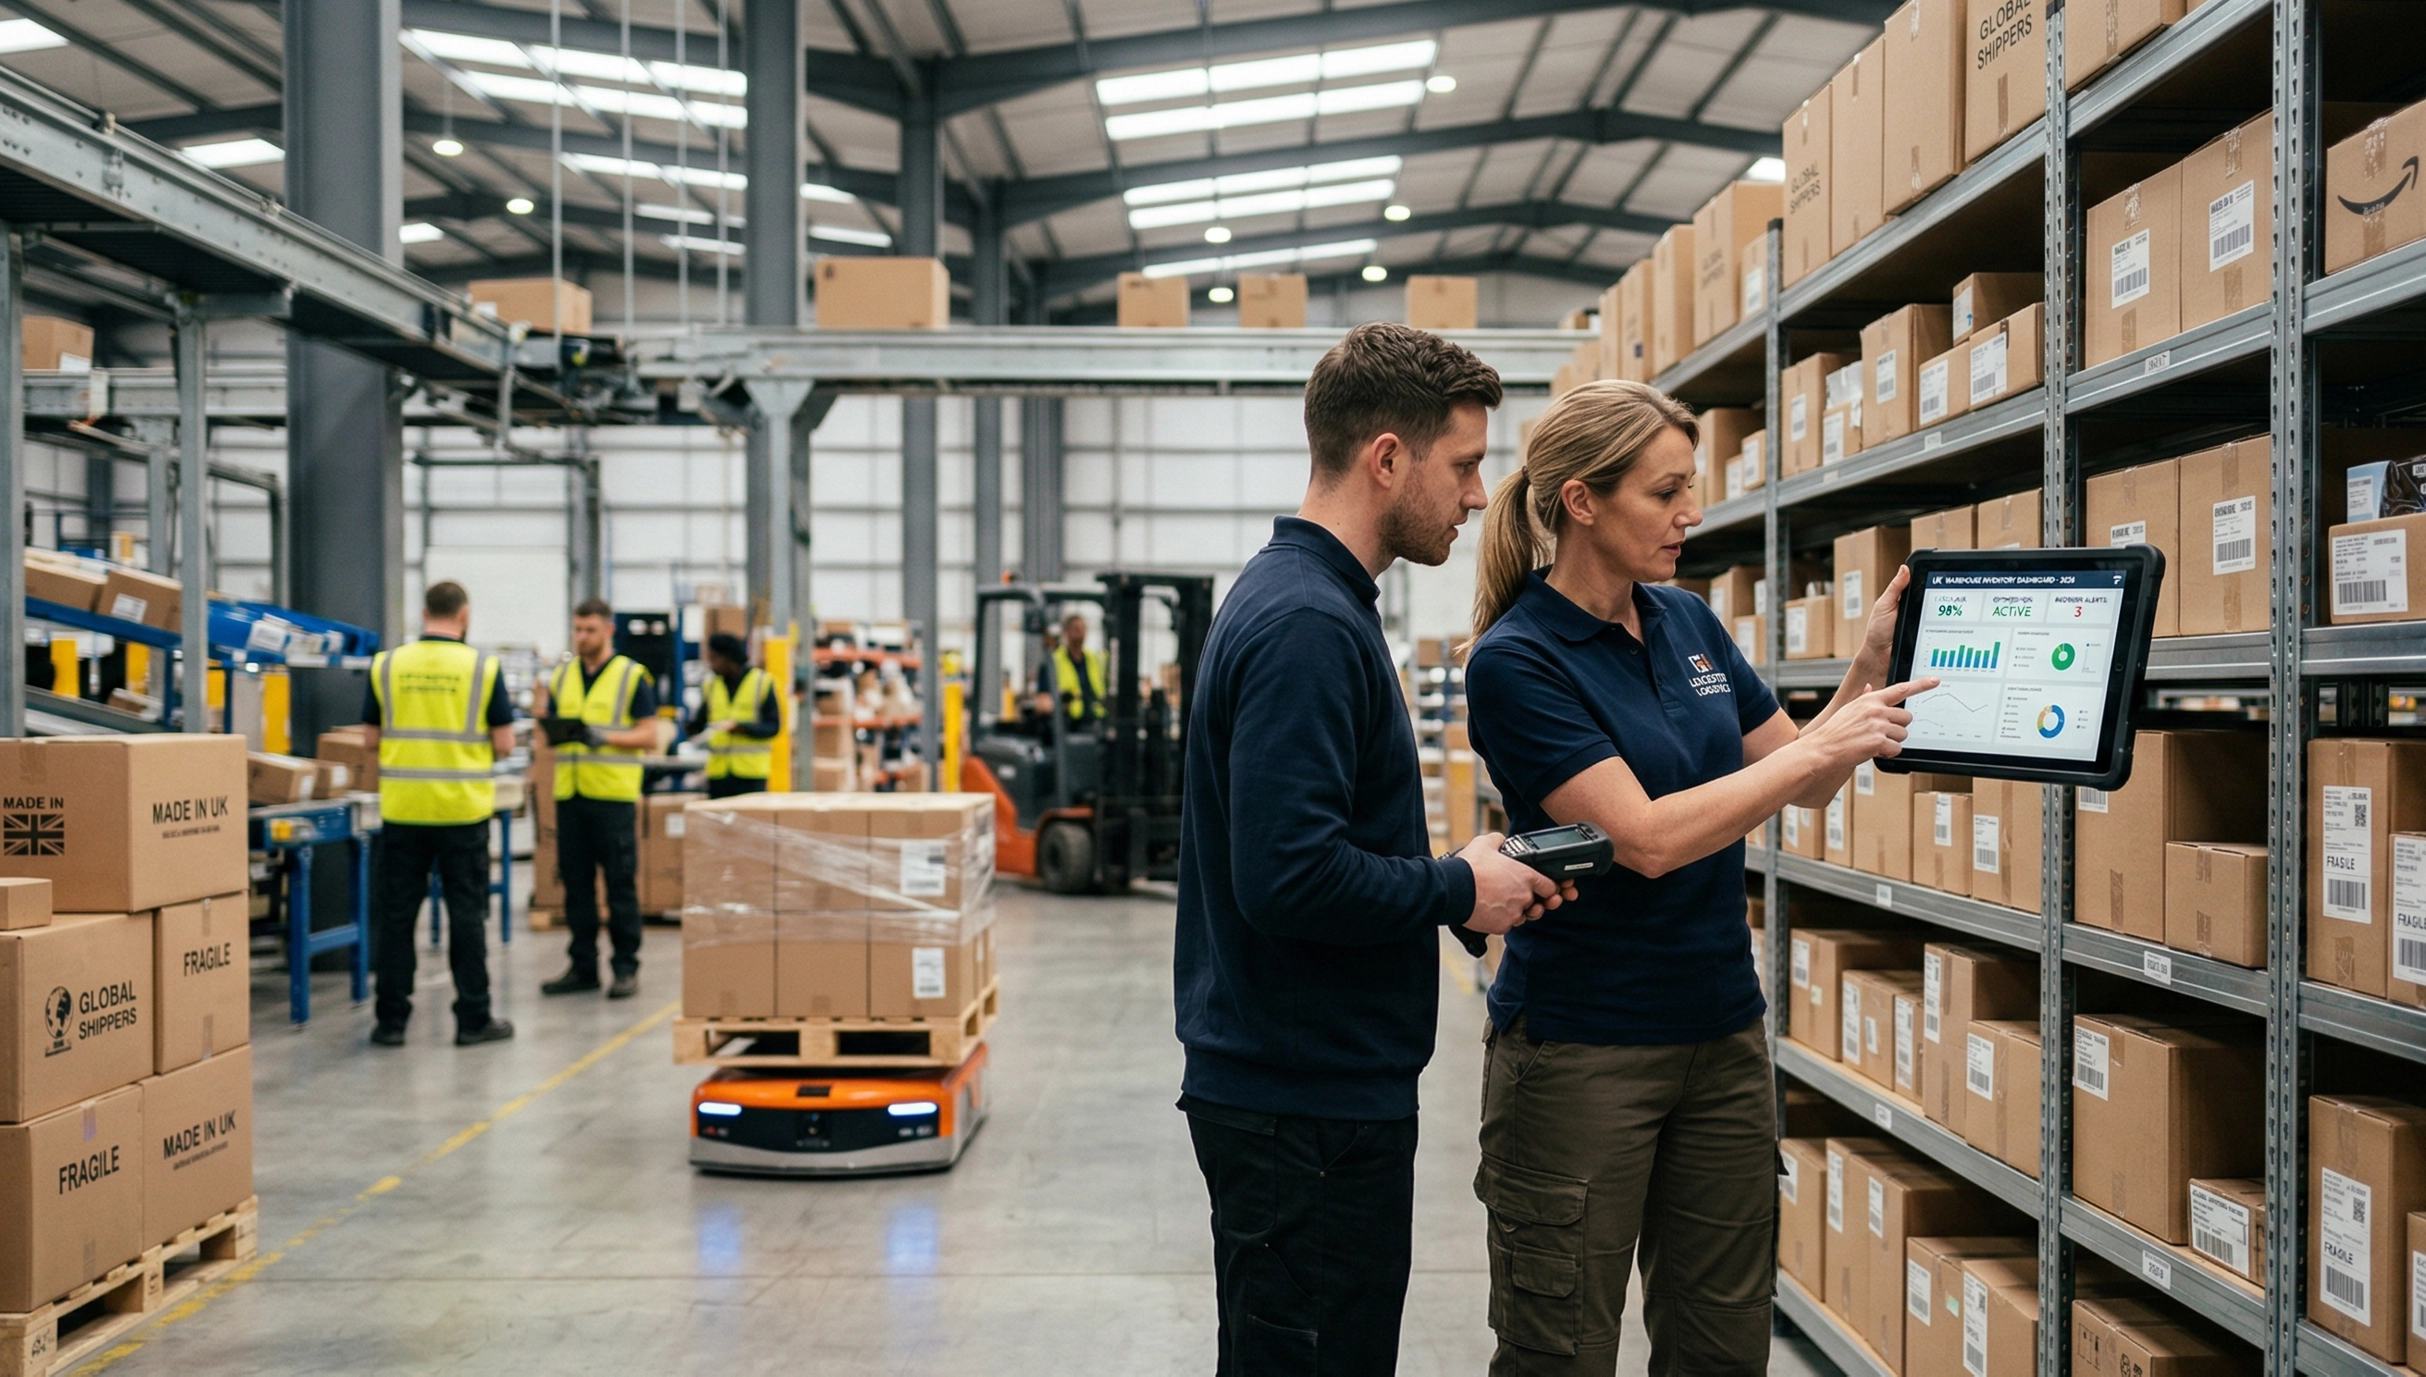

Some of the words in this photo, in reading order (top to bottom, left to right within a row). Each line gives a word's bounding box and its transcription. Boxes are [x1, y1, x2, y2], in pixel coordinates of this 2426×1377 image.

[1977, 13, 2032, 70] SHIPPERS
[1938, 605, 1962, 617] 98%
[1992, 606, 2032, 617] ACTIVE
[2074, 606, 2082, 617] 3
[4, 797, 45, 809] MADE
[50, 797, 64, 809] IN
[153, 800, 191, 825] MADE
[195, 798, 208, 820] IN
[211, 795, 229, 817] UK
[184, 942, 231, 977] FRAGILE
[79, 980, 137, 1015] GLOBAL
[79, 1007, 137, 1040] SHIPPERS
[164, 1124, 200, 1160] MADE
[204, 1117, 216, 1142] IN
[219, 1110, 236, 1135] UK
[59, 1145, 120, 1195] FRAGILE
